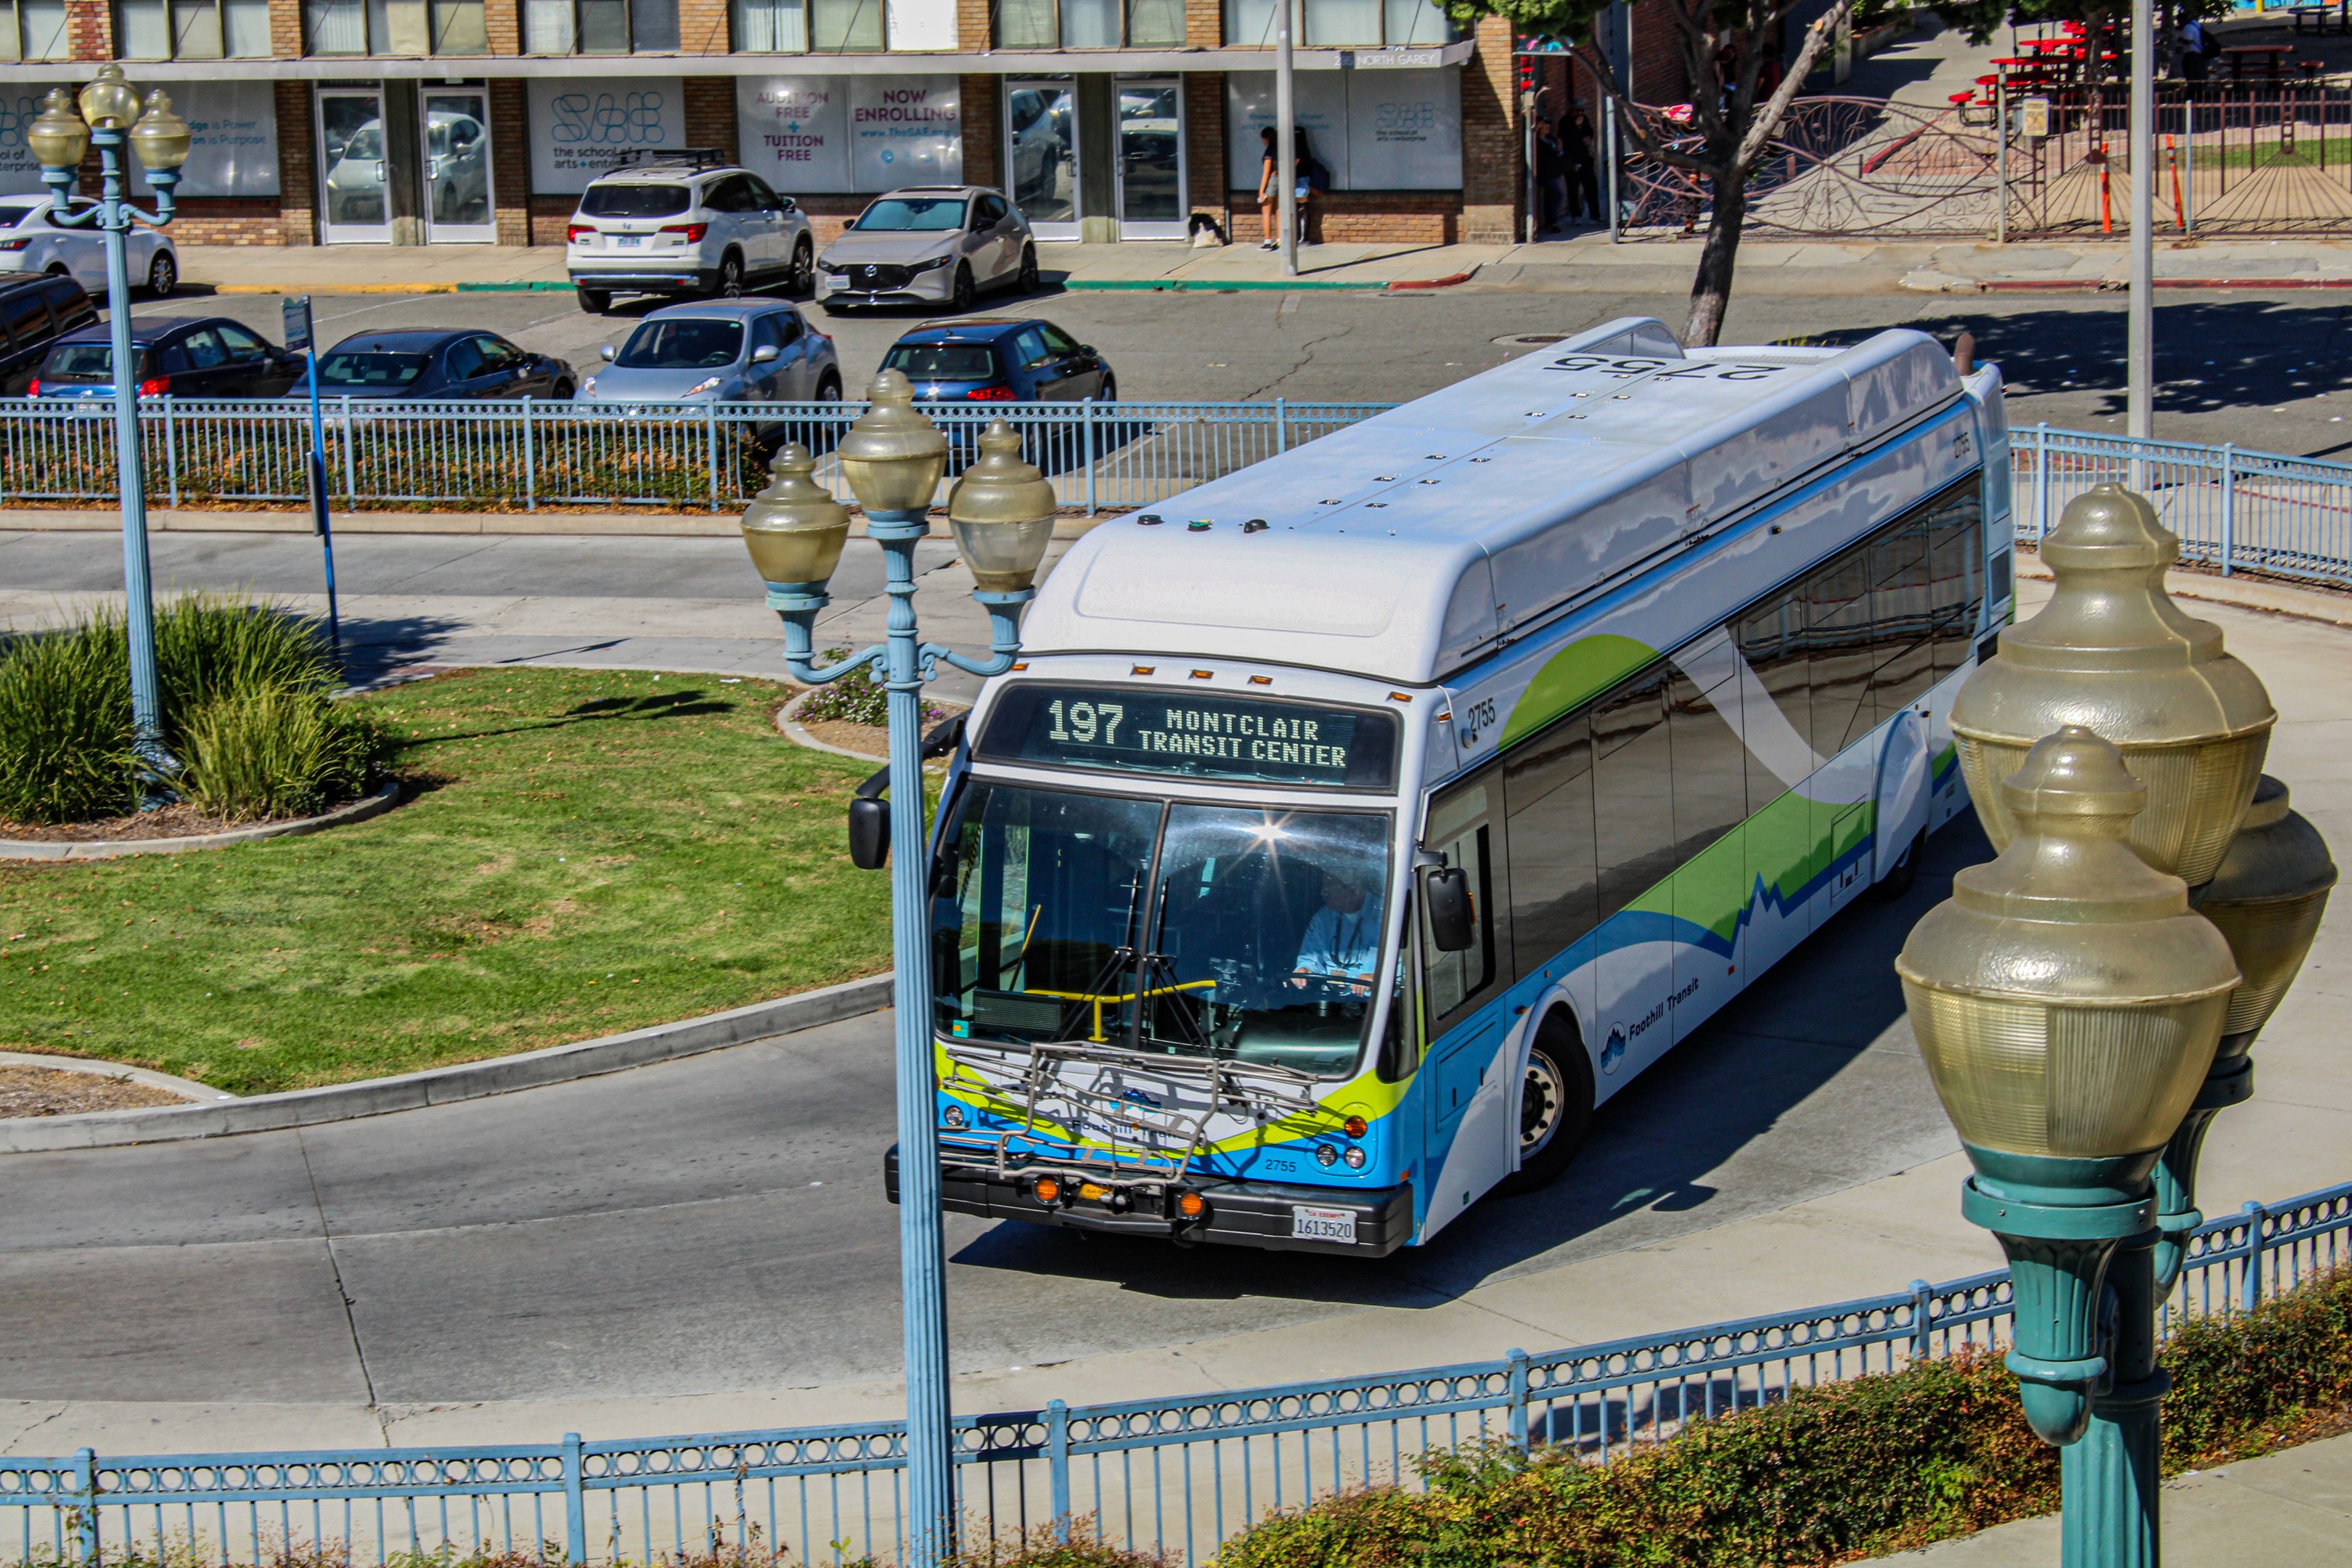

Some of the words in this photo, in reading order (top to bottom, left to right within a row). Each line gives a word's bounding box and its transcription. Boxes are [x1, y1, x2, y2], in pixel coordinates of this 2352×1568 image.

[1357, 54, 1395, 65] NORTH
[1397, 54, 1435, 65] GAREY
[756, 92, 829, 104] AUDITON
[883, 89, 926, 104] NOW
[776, 106, 810, 118] FREE
[855, 107, 957, 122] ENROLLING
[223, 119, 256, 129] Power
[764, 135, 824, 147] TUITION
[13, 150, 25, 160] of
[553, 147, 576, 157] the
[578, 147, 616, 158] school
[777, 150, 812, 160] FREE
[554, 158, 577, 168] arts
[1543, 356, 1787, 380] 2755
[1468, 697, 1495, 732] 2755
[1048, 700, 1124, 745] 197
[1166, 709, 1319, 741] MONTCLAIR
[1138, 730, 1242, 758] TRANSIT
[1251, 740, 1346, 767] CENTER
[1629, 1002, 1664, 1041] Foothill
[1667, 978, 1699, 1011] Transit
[1265, 1159, 1297, 1172] 2755
[1297, 1219, 1352, 1238] 1613520
